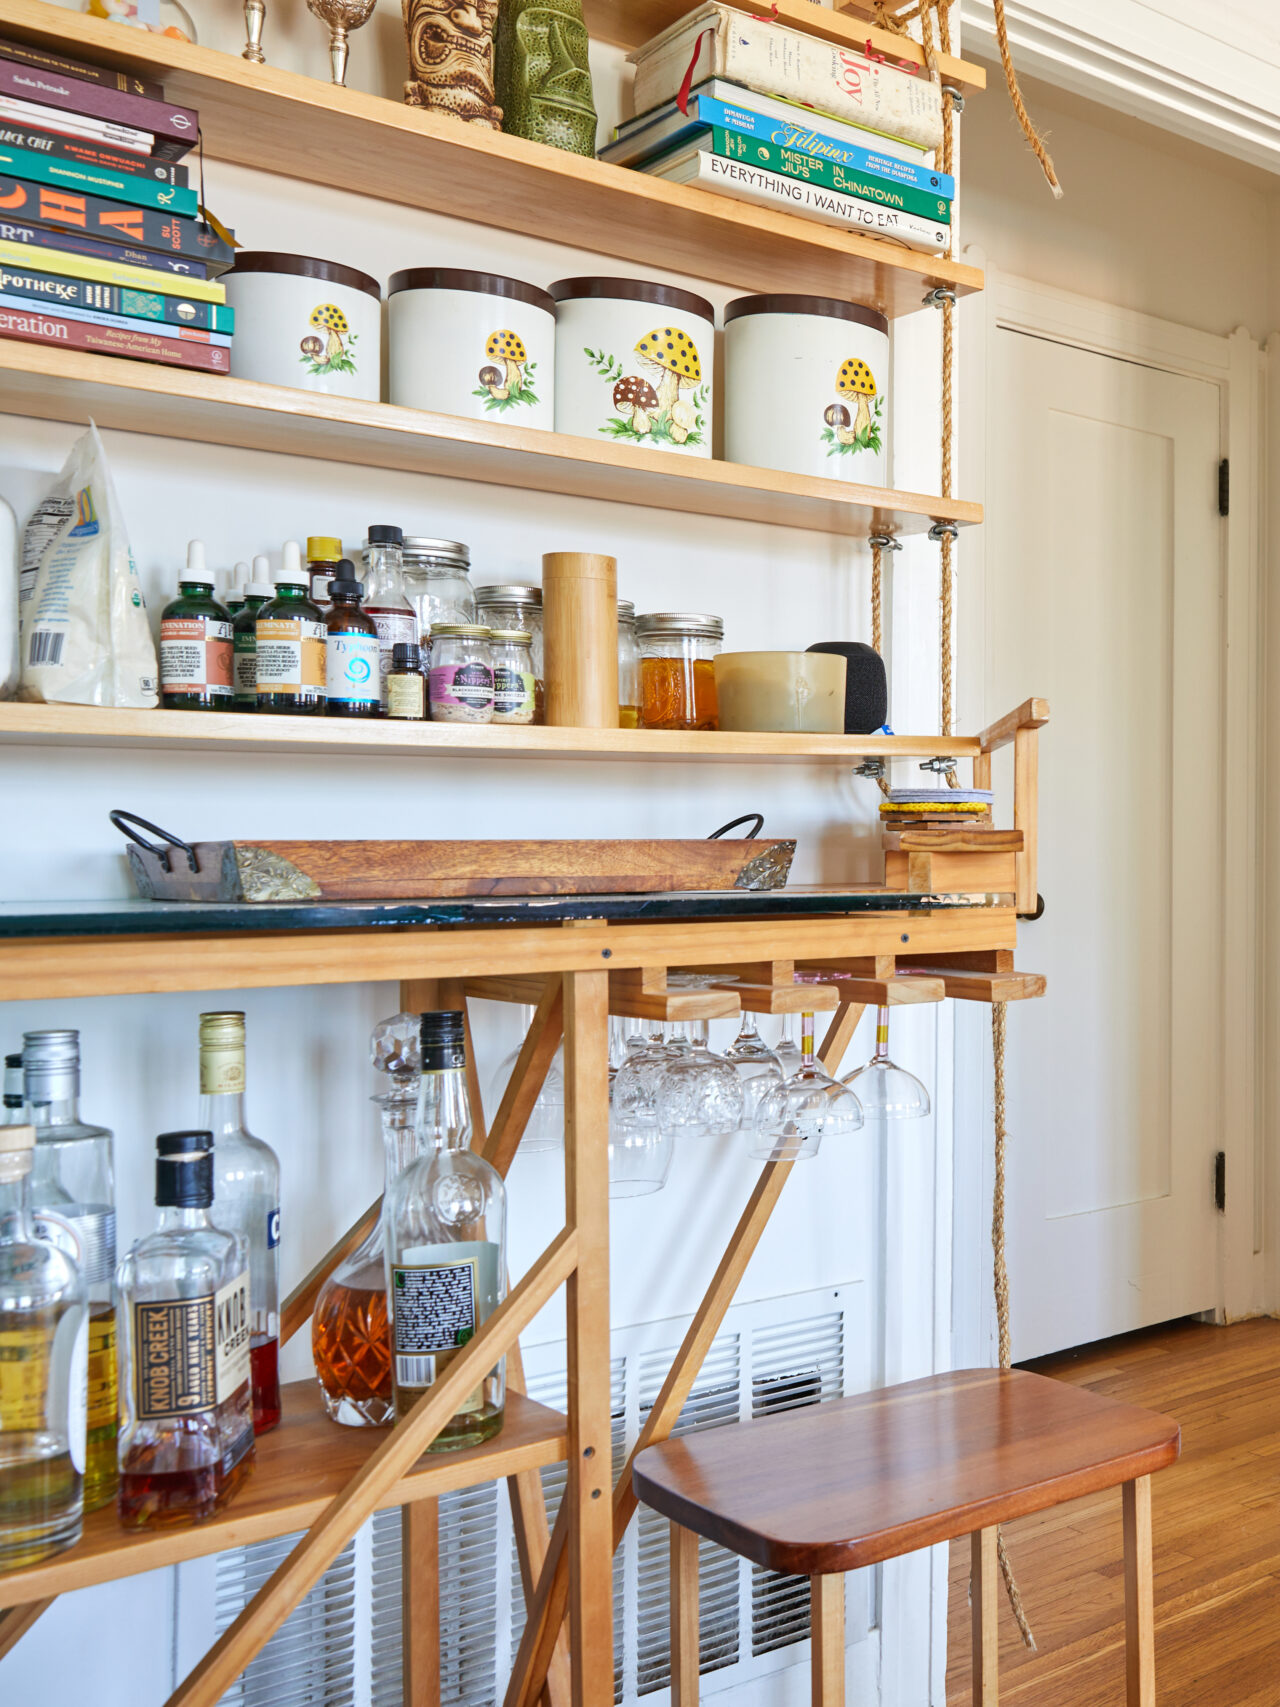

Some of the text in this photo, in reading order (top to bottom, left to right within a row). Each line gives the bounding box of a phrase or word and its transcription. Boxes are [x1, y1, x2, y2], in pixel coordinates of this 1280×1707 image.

[771, 120, 856, 164] Filipinx
[781, 149, 845, 178] MISTER IN
[711, 158, 899, 227] EVERYTHING I WANT TO EAT
[781, 160, 904, 207] JIU'S CHINATOWN
[162, 226, 171, 238] SU
[172, 219, 182, 249] SCOTT
[161, 346, 182, 359] Home
[149, 1307, 171, 1411] KNOB CREEK
[177, 1394, 200, 1407] 9
